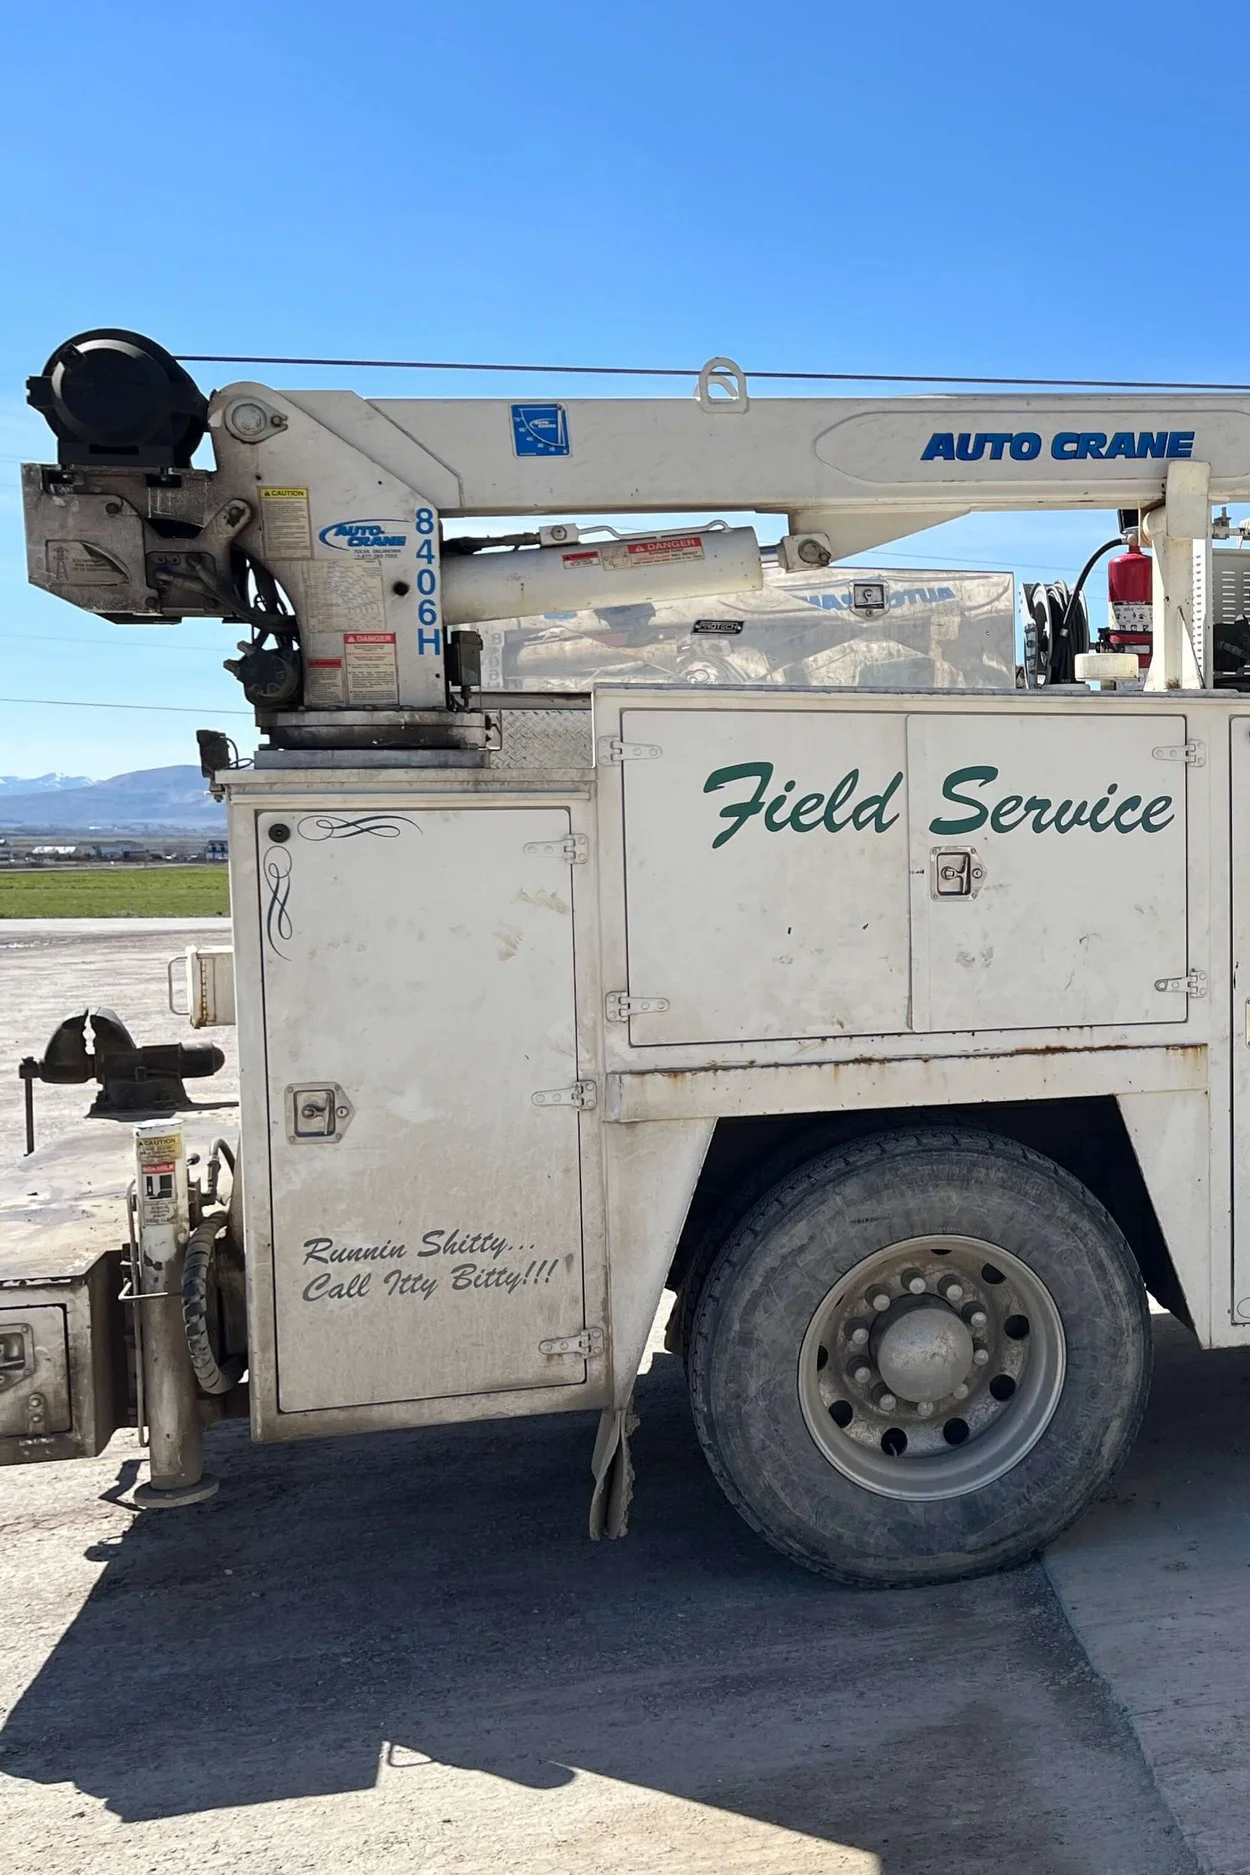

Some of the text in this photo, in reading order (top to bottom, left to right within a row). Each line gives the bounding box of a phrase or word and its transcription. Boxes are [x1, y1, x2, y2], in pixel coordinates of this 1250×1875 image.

[920, 431, 1195, 461] AUTO CRANE
[347, 535, 407, 547] CRANE
[647, 539, 696, 550] DANGER
[703, 761, 1175, 849] Field Service
[143, 1138, 176, 1147] CAUTION
[303, 1229, 535, 1266] Runnin Shitty...
[302, 1258, 559, 1302] Call Itty Bitty!!!
